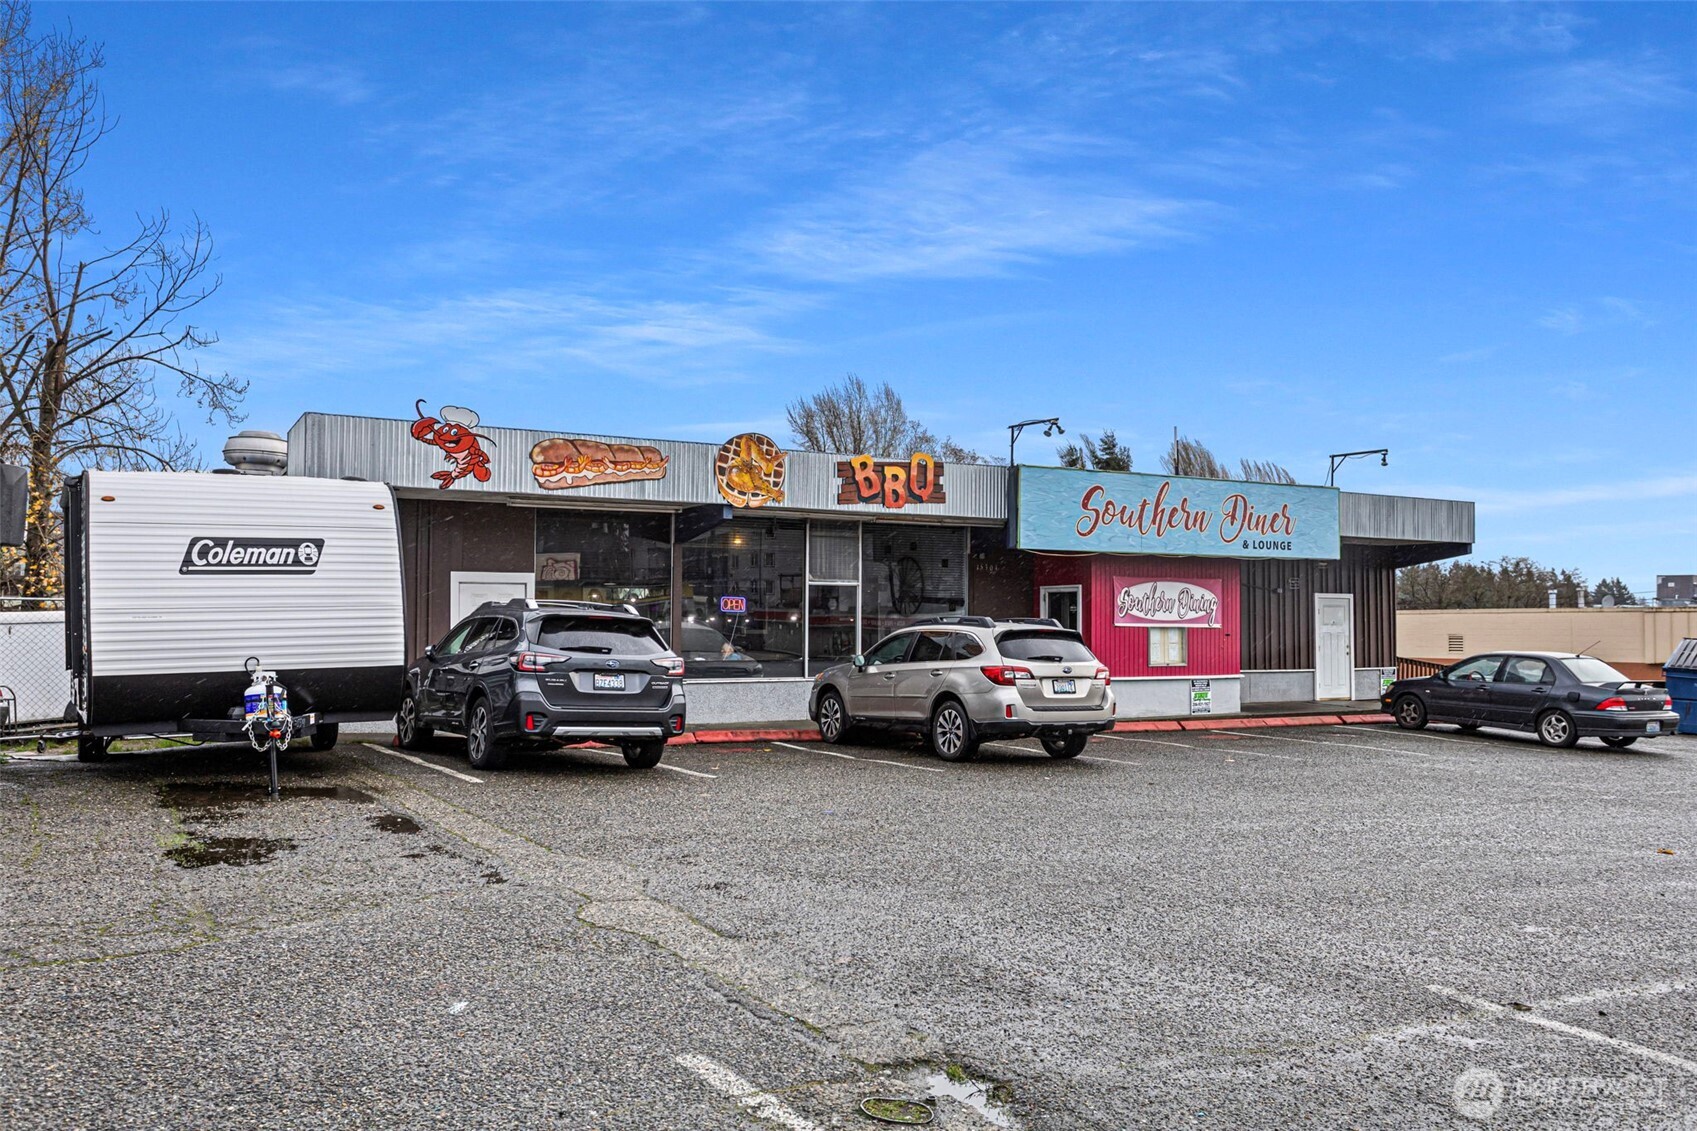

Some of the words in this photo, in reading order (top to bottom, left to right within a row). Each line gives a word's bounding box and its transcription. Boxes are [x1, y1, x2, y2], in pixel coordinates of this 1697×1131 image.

[850, 452, 934, 508] BBQ
[1076, 481, 1212, 538] Southern
[1219, 493, 1296, 543] Diner
[191, 539, 296, 566] Coleman
[1242, 540, 1249, 549] &
[1252, 540, 1292, 550] LOUNGE
[722, 598, 745, 611] OPEN
[1118, 581, 1176, 618] Southern
[1176, 587, 1218, 626] Dining
